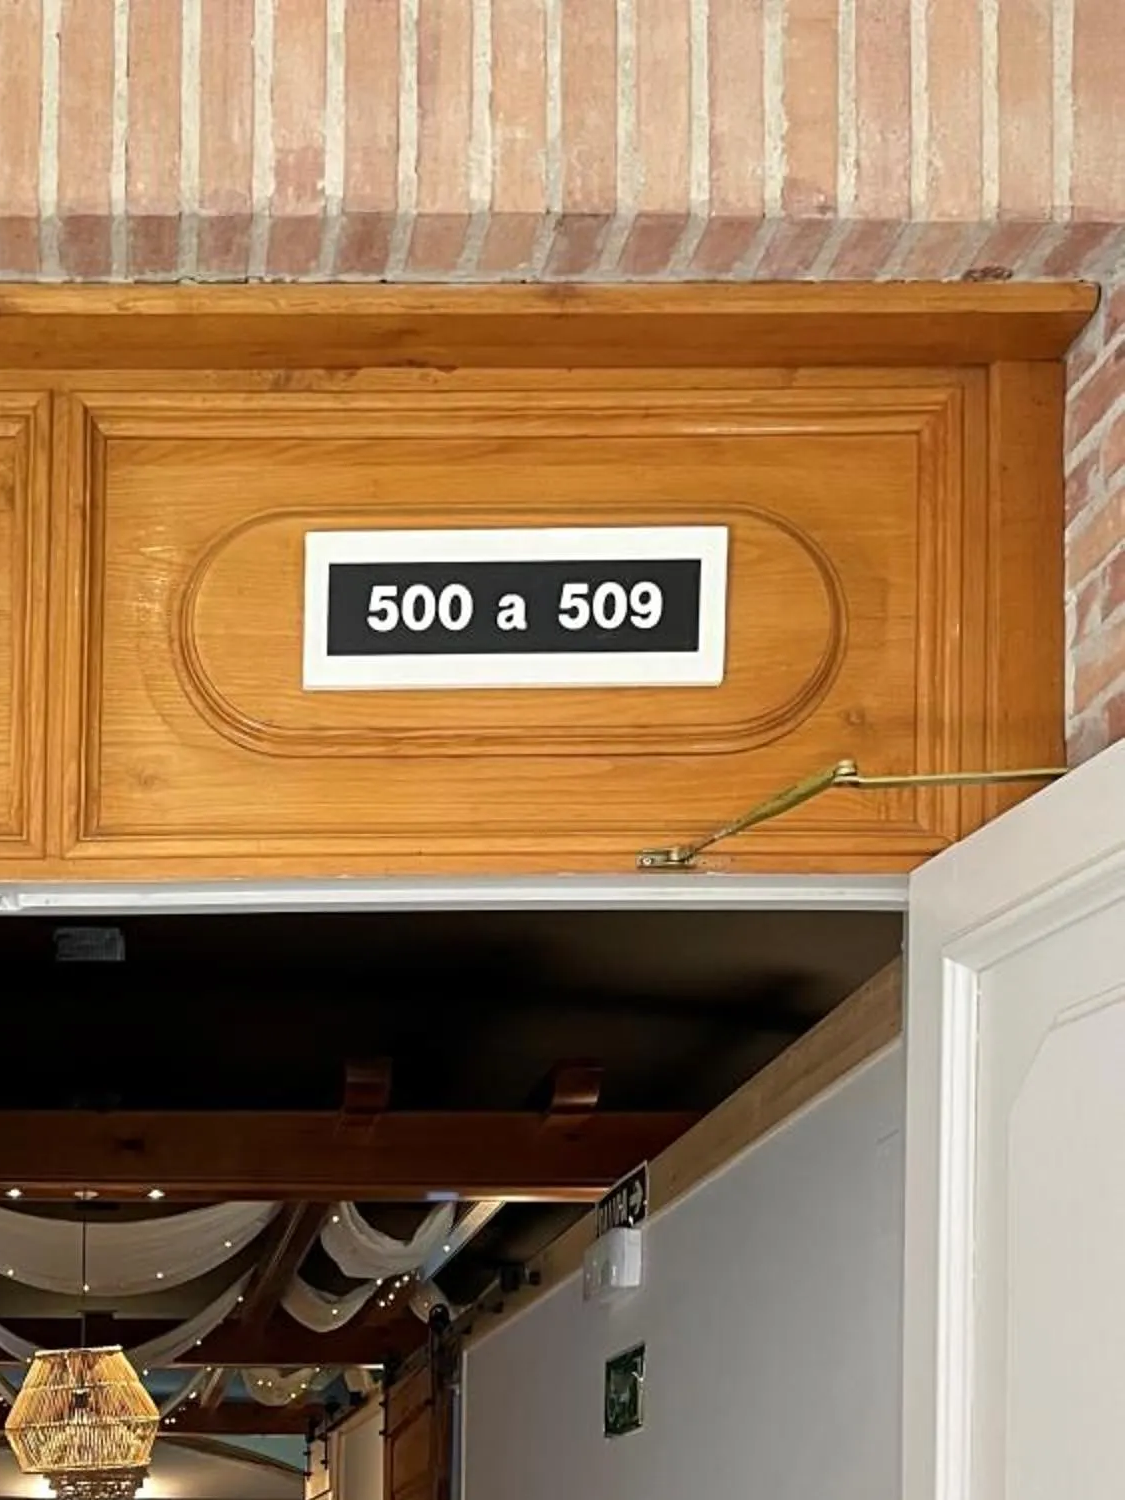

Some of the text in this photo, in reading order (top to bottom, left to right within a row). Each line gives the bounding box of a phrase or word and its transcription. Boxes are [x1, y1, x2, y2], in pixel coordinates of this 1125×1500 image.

[367, 581, 663, 632] 500 a 509
